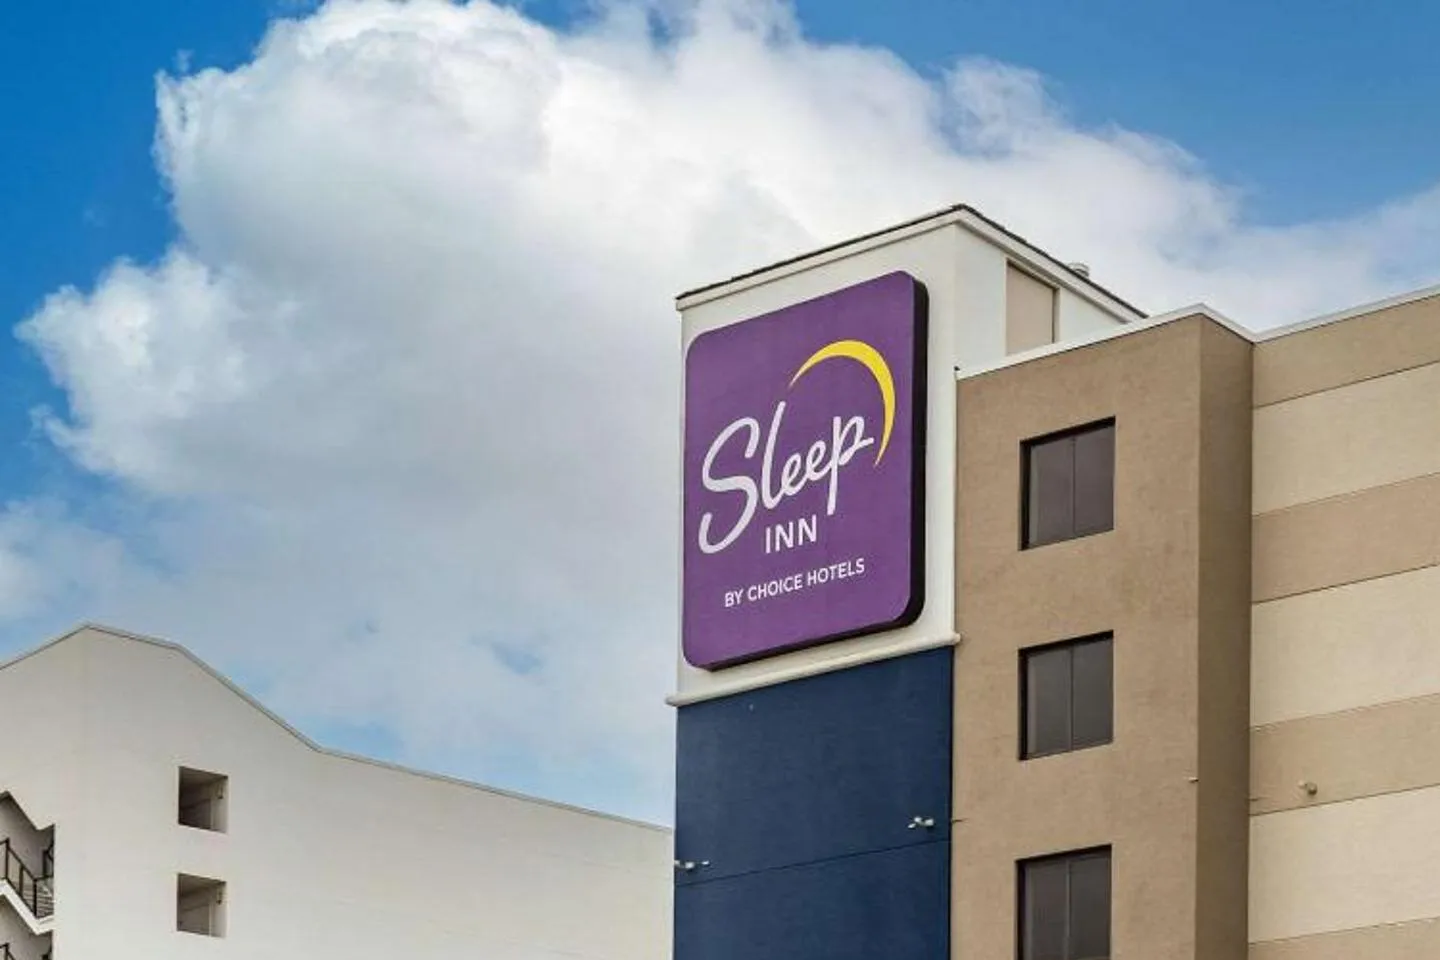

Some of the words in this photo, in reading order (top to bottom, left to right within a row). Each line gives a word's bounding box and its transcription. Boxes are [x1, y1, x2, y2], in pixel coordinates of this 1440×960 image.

[698, 400, 875, 554] Sleep
[765, 514, 817, 554] INN
[724, 588, 744, 608] BY
[747, 573, 803, 602] CHOICE
[806, 557, 865, 586] HOTELS
